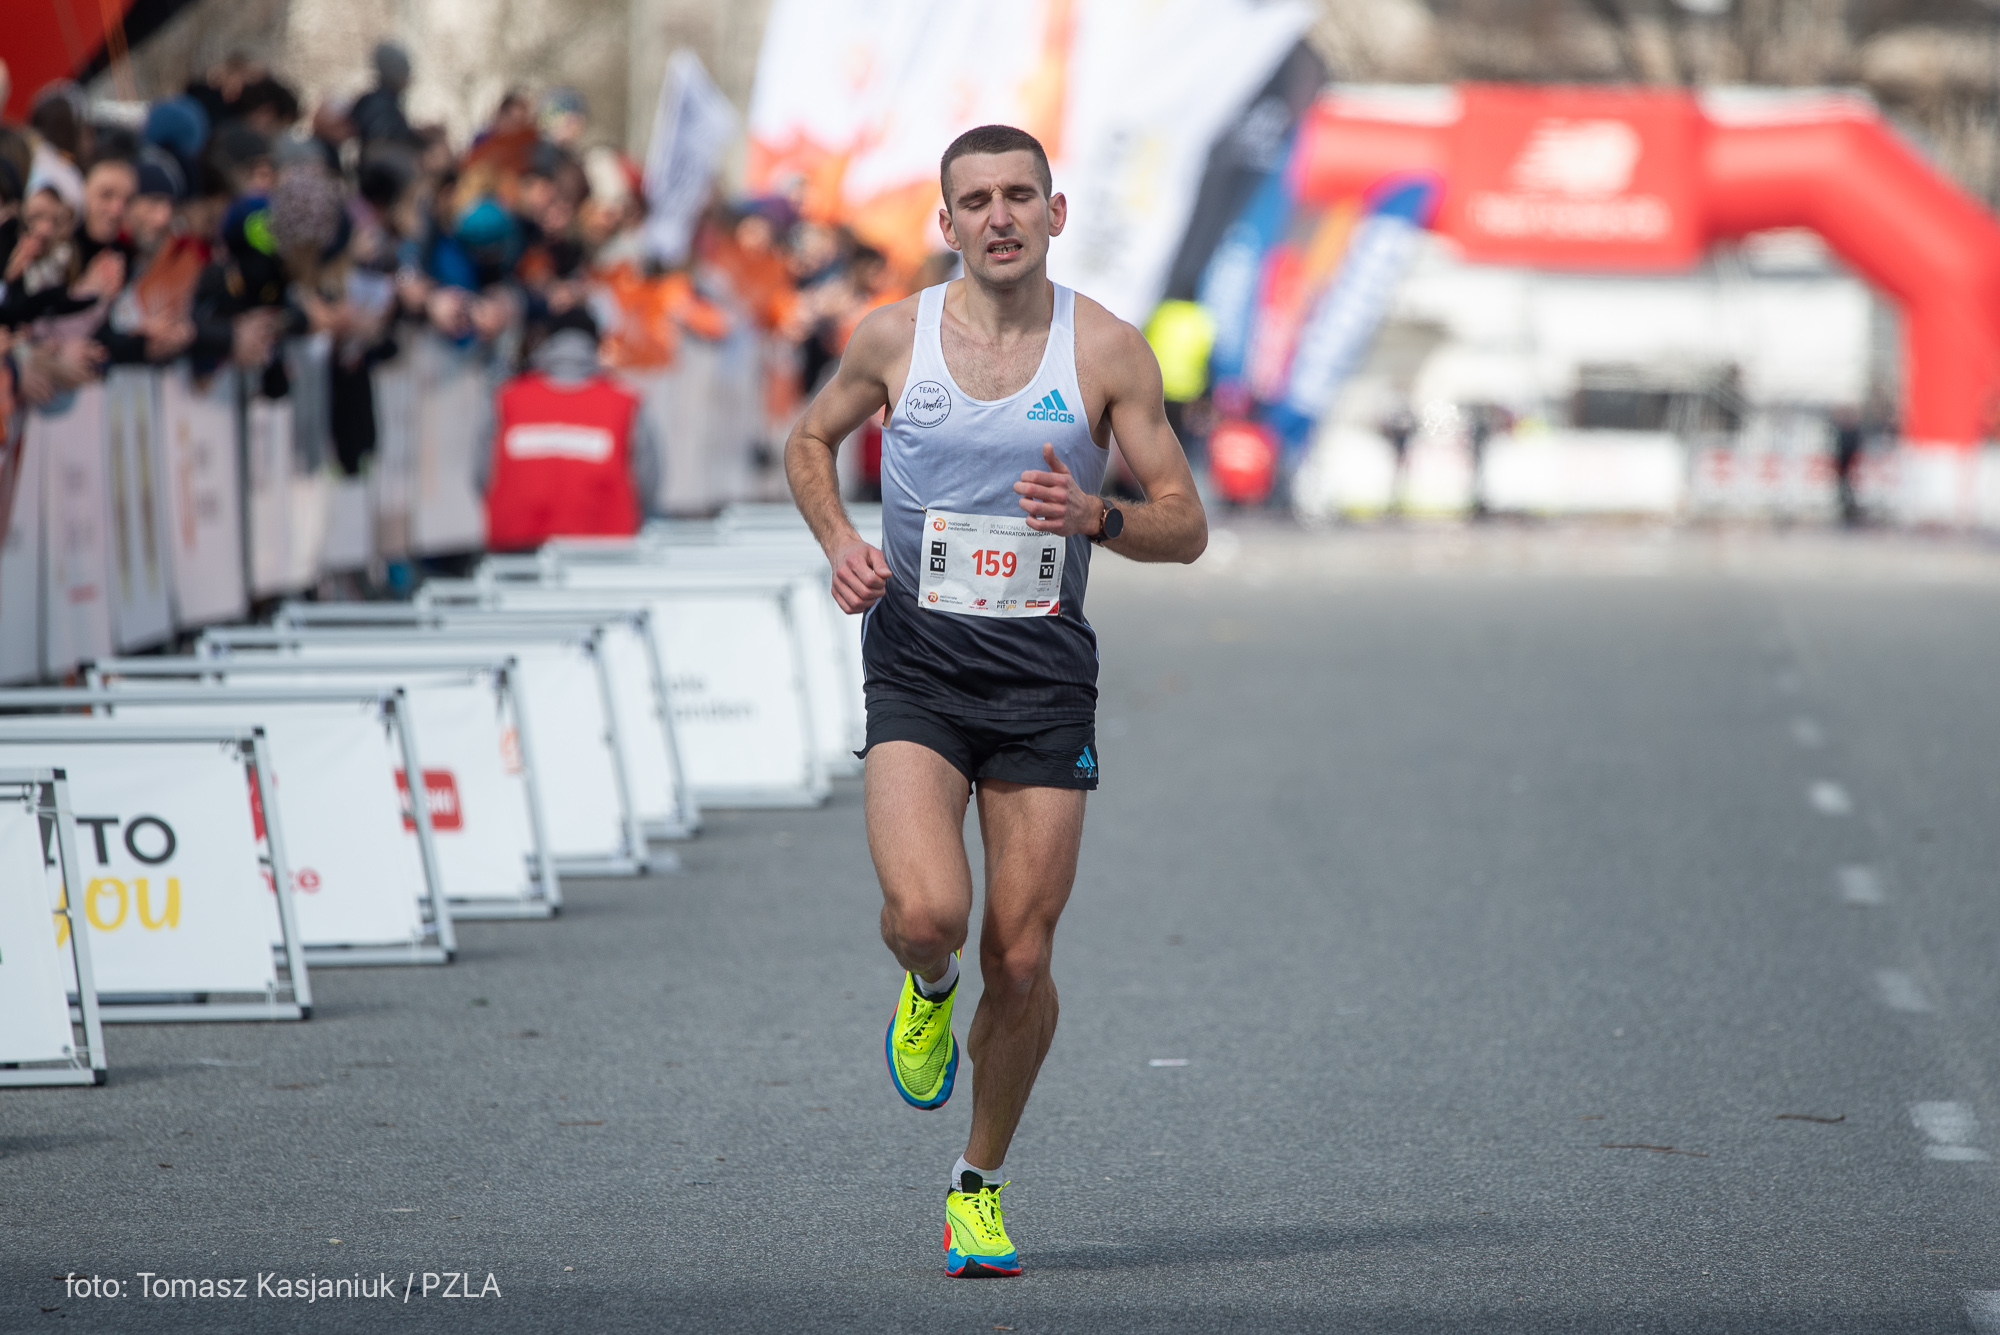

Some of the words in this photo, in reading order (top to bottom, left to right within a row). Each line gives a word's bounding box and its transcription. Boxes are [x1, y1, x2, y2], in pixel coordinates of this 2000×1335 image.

[919, 386, 940, 394] TEAM
[909, 395, 946, 412] Wanda
[1026, 408, 1075, 424] adidas
[972, 549, 1018, 578] 159
[76, 814, 178, 867] TO
